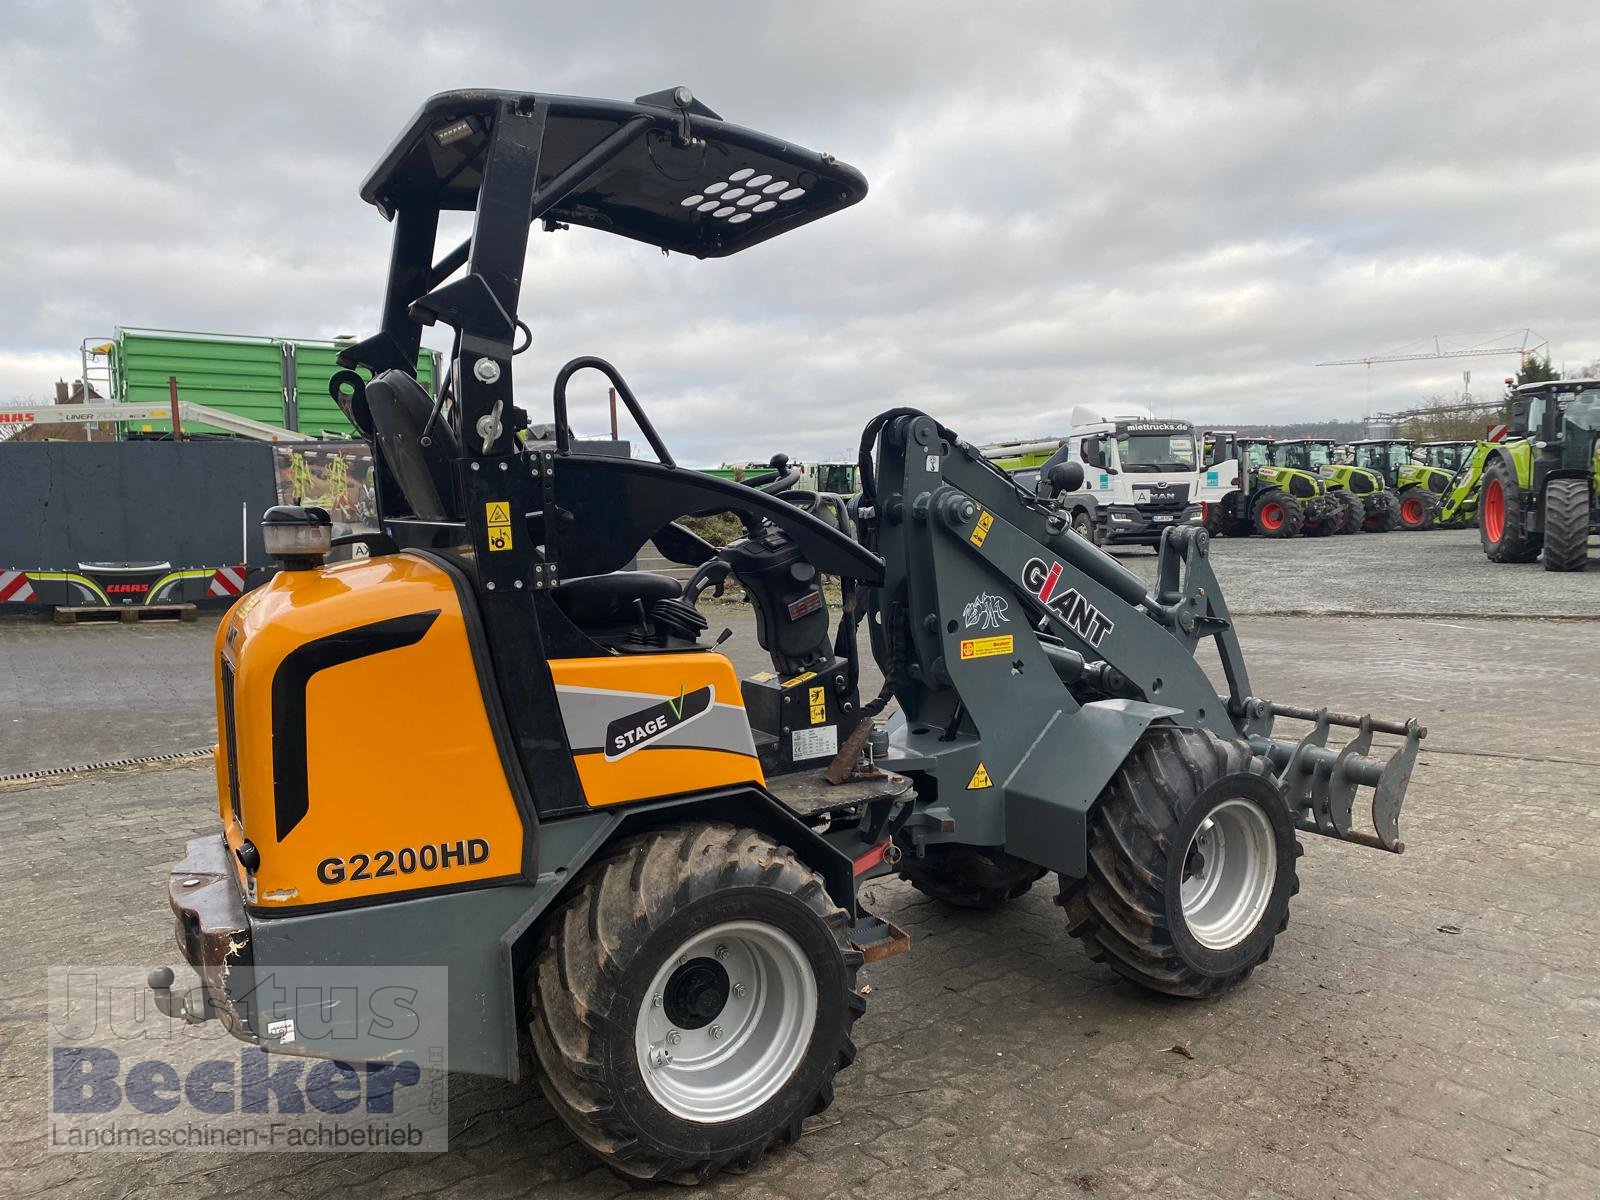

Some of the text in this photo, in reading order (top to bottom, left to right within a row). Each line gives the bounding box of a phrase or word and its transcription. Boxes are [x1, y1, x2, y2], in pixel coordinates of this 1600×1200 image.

[1127, 423, 1188, 431] miettrucks.de
[1138, 492, 1147, 502] A
[106, 583, 149, 592] CLAAS
[614, 714, 668, 749] STAGE
[316, 837, 490, 885] G2200HD
